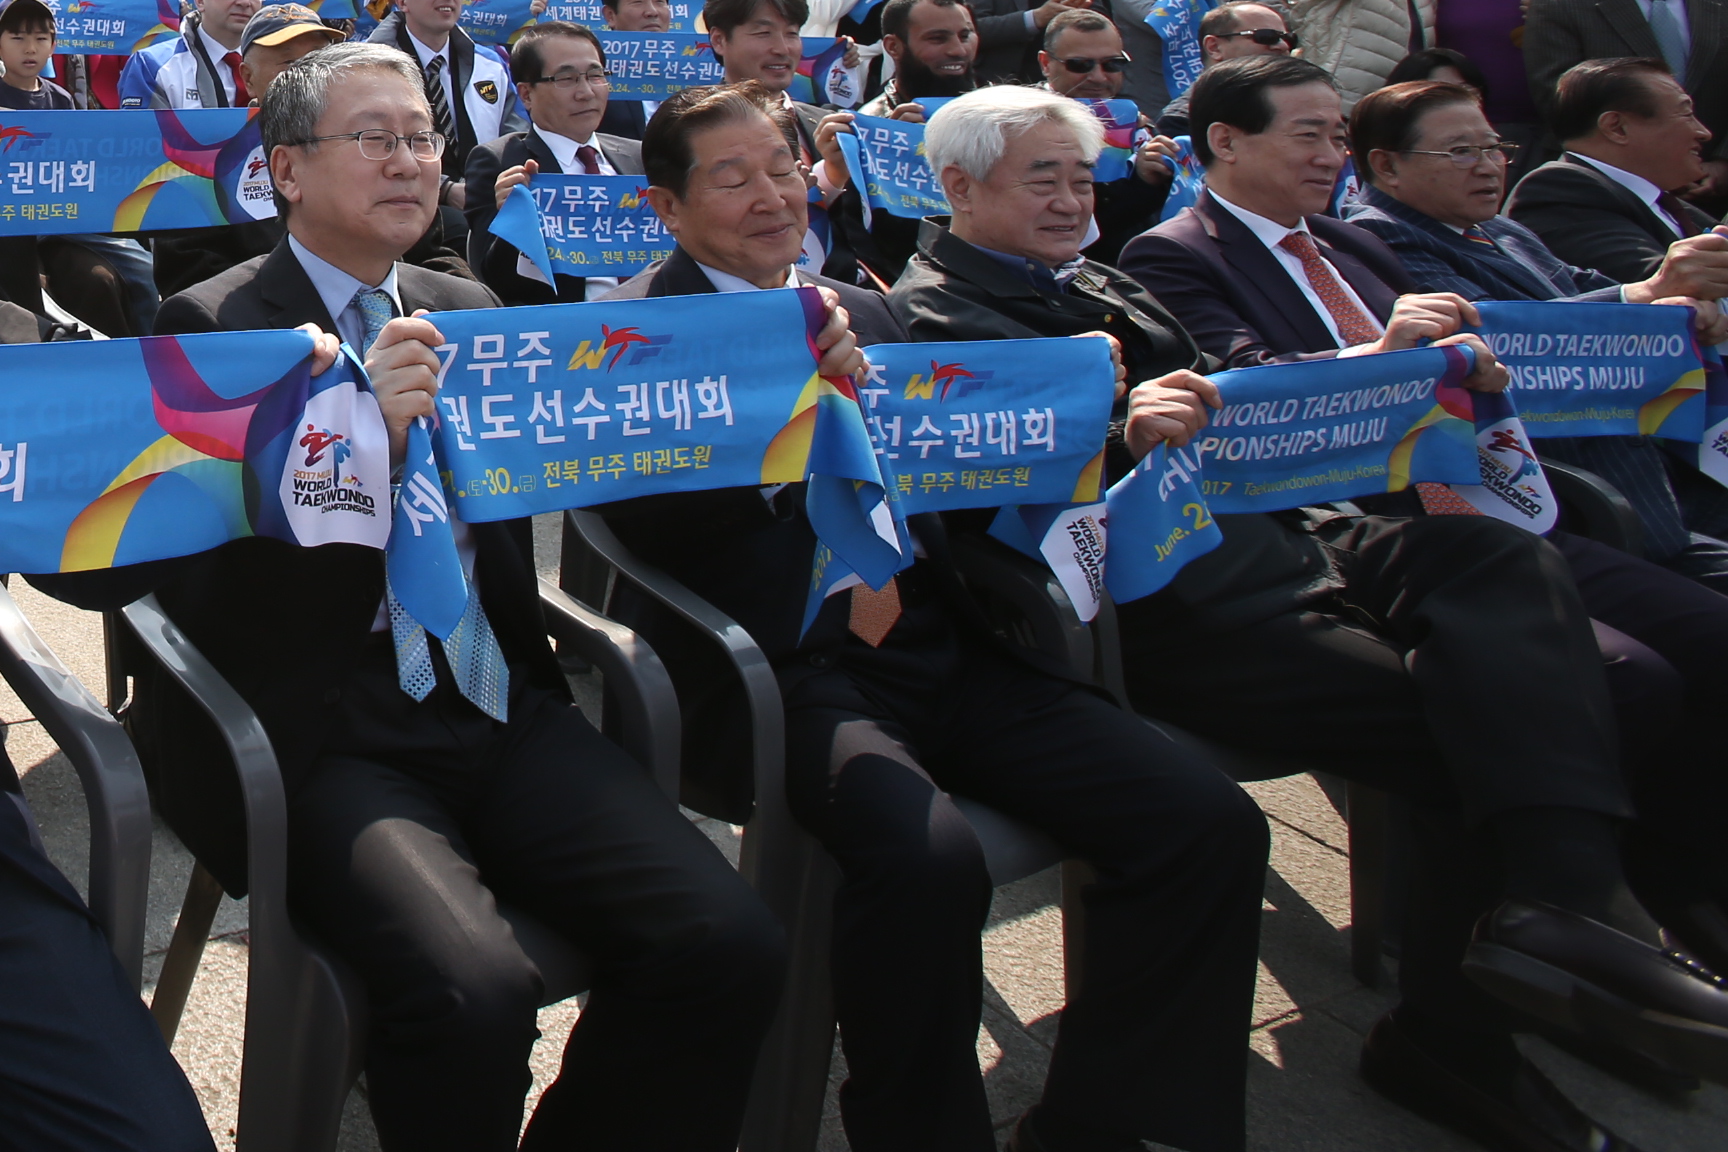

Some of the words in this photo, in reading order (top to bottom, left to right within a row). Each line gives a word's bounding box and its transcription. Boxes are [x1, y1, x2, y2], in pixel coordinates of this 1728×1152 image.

[603, 40, 639, 58] 2017
[642, 40, 676, 58] 무주
[870, 128, 909, 157] 무주
[21, 201, 78, 220] 태권도원
[561, 186, 610, 213] 무주
[601, 250, 624, 264] 전북
[626, 250, 648, 264] 무주
[466, 330, 552, 389] 무주
[567, 323, 672, 374] WTF
[1555, 333, 1685, 358] TAEKWONDO
[903, 359, 995, 404] WTF
[1589, 366, 1645, 391] MUJU
[440, 374, 735, 452] 권도선수권대회
[1212, 397, 1297, 428] WORLD
[1303, 377, 1436, 415] TAEKWONDO
[1328, 416, 1388, 450] MUJU
[293, 469, 316, 480] 2017
[543, 458, 581, 490] 전북
[585, 453, 627, 484] 무주
[633, 444, 712, 478] 태권도원
[1478, 454, 1509, 480] ORLD
[292, 479, 332, 492] WORLD
[919, 469, 955, 494] 무주
[961, 467, 1031, 491] 태권도원
[292, 489, 376, 509] TAEKWONDO
[321, 503, 376, 517] CHAMPIONSHIPS
[1076, 517, 1102, 558] WORLD
